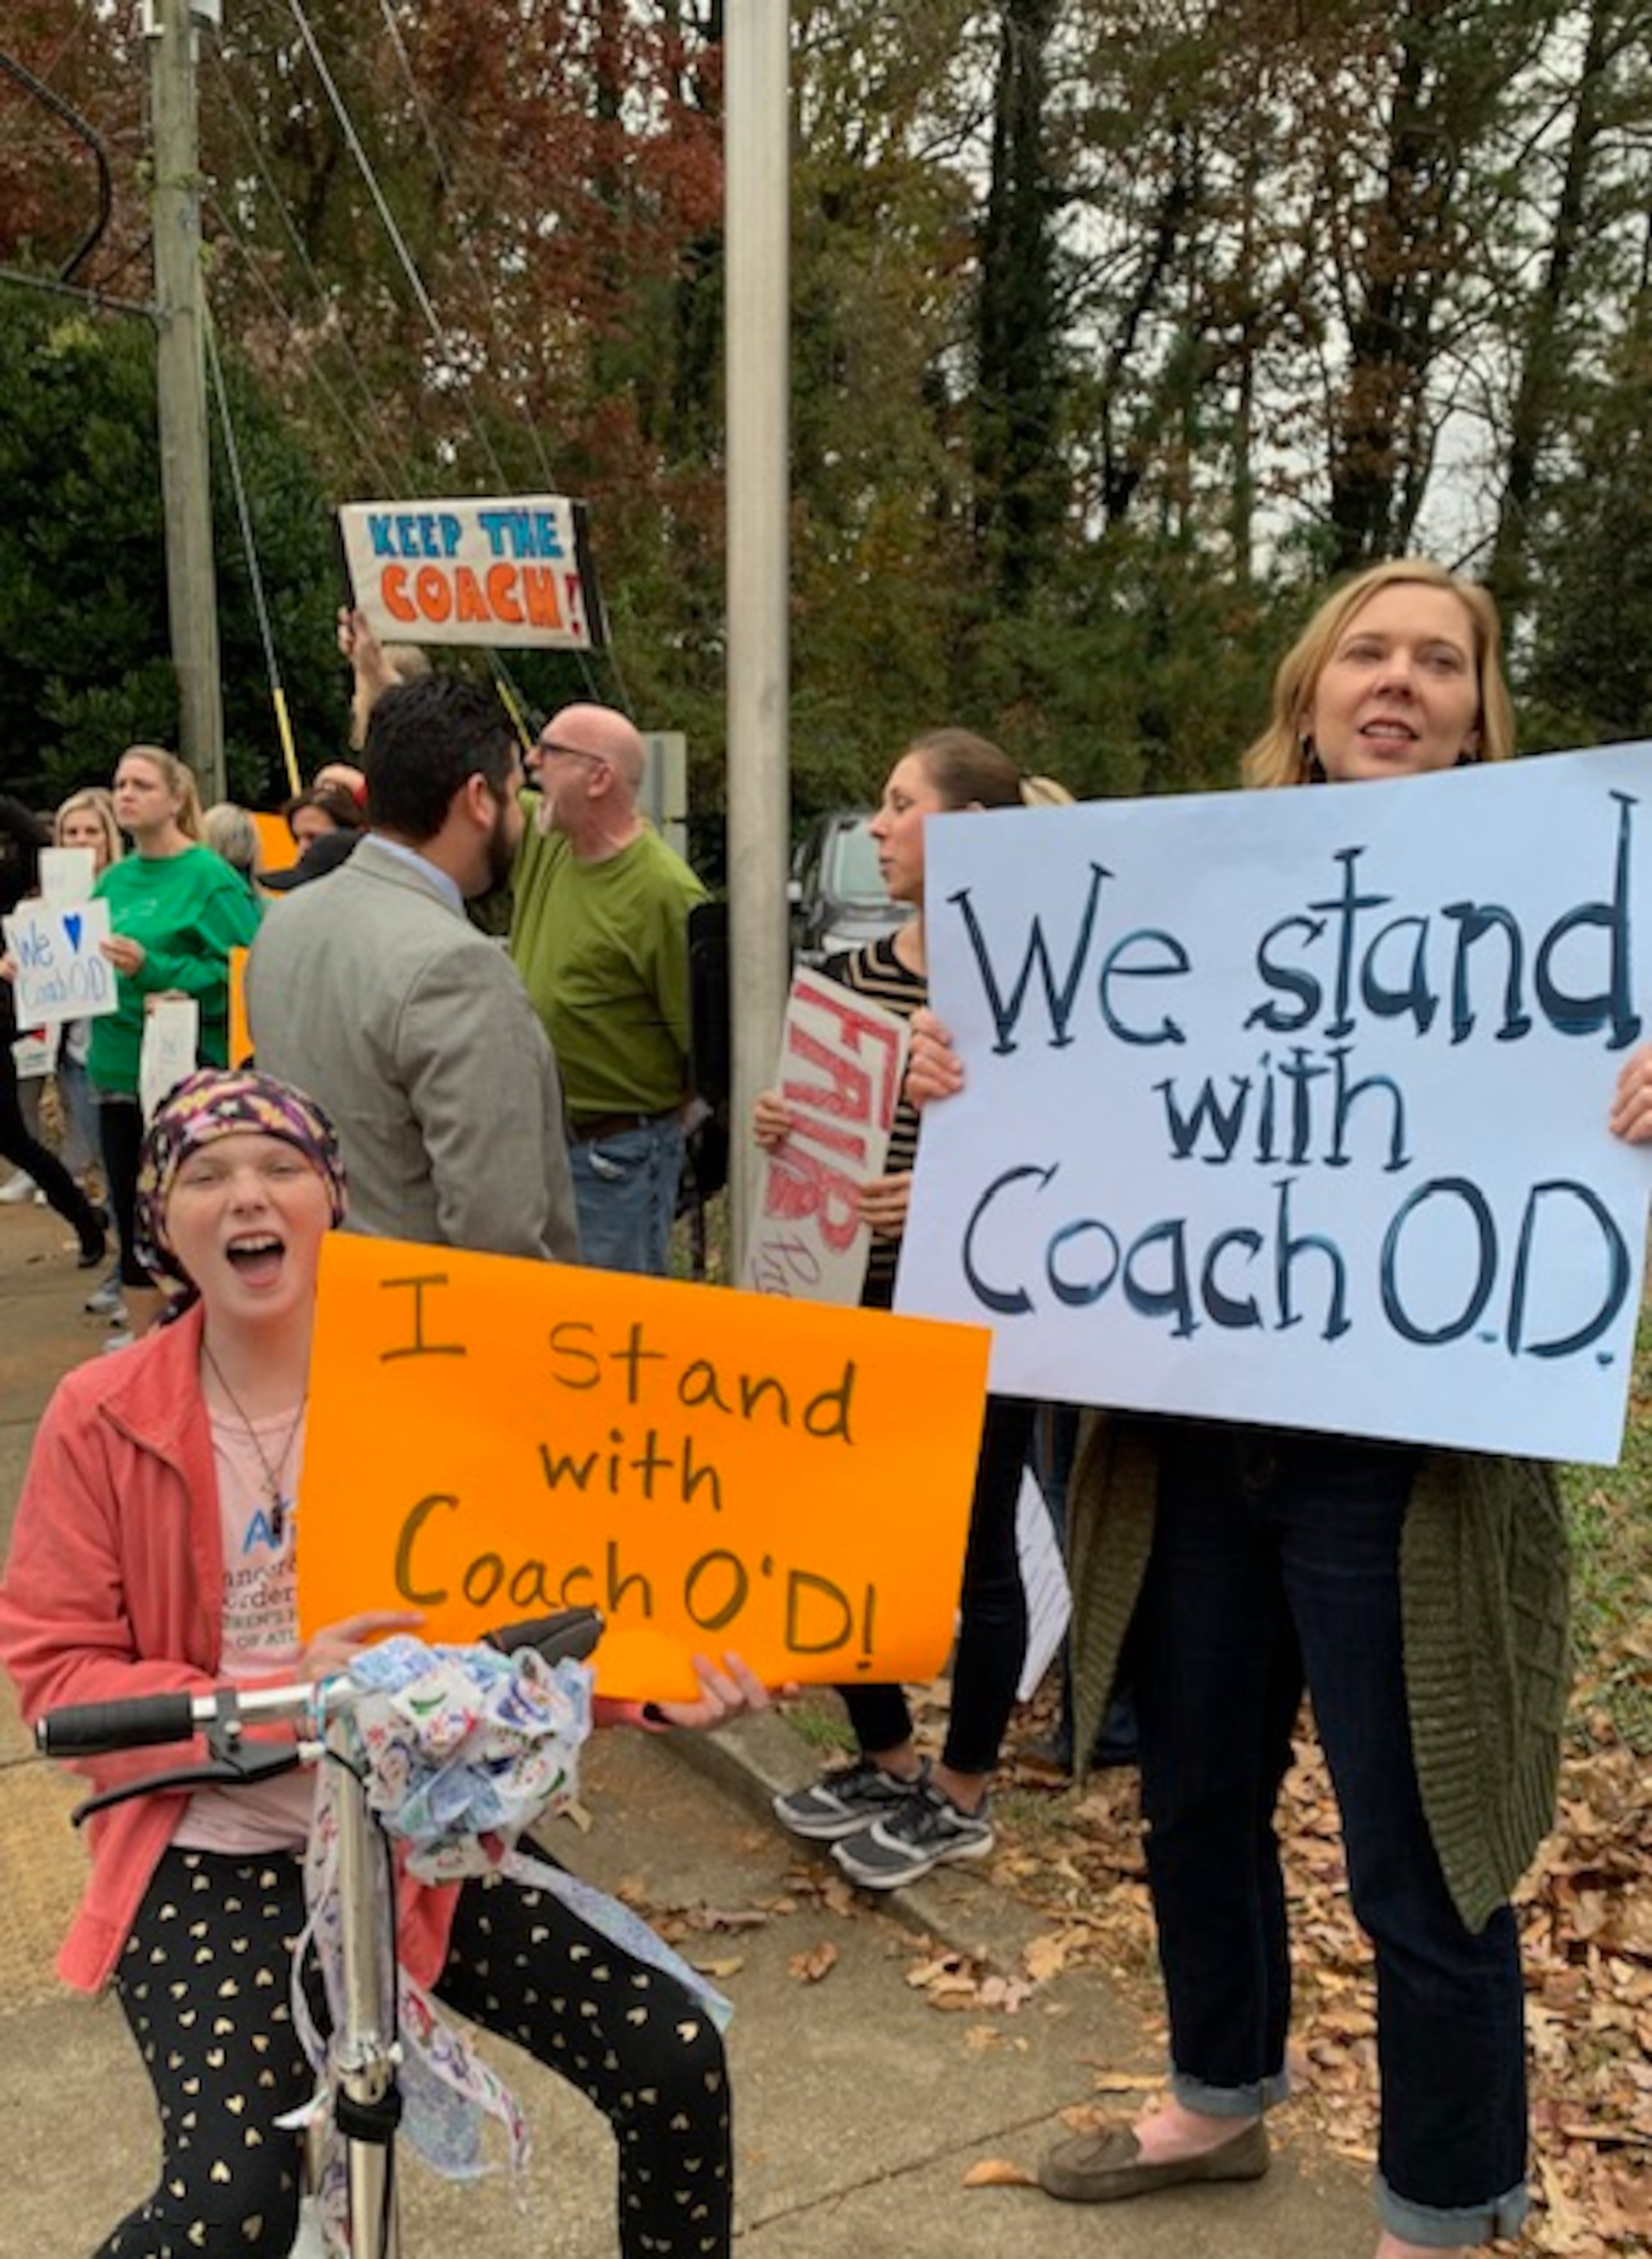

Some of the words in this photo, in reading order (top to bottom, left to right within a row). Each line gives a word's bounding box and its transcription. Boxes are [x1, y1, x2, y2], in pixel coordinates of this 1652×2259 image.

[367, 512, 462, 557] KEEP
[477, 508, 564, 558] THE
[381, 561, 580, 638] COACH!
[11, 918, 53, 969] We
[946, 862, 1191, 1055] We
[1242, 789, 1642, 1051] stand
[766, 981, 901, 1253] FAIR
[1151, 1045, 1415, 1173] with
[379, 1272, 467, 1363] I
[962, 1162, 1353, 1341] Coach
[1379, 1176, 1632, 1369] O.D.
[538, 1427, 724, 1512] with
[393, 1493, 653, 1620] Coach
[683, 1547, 878, 1672] O'D!
